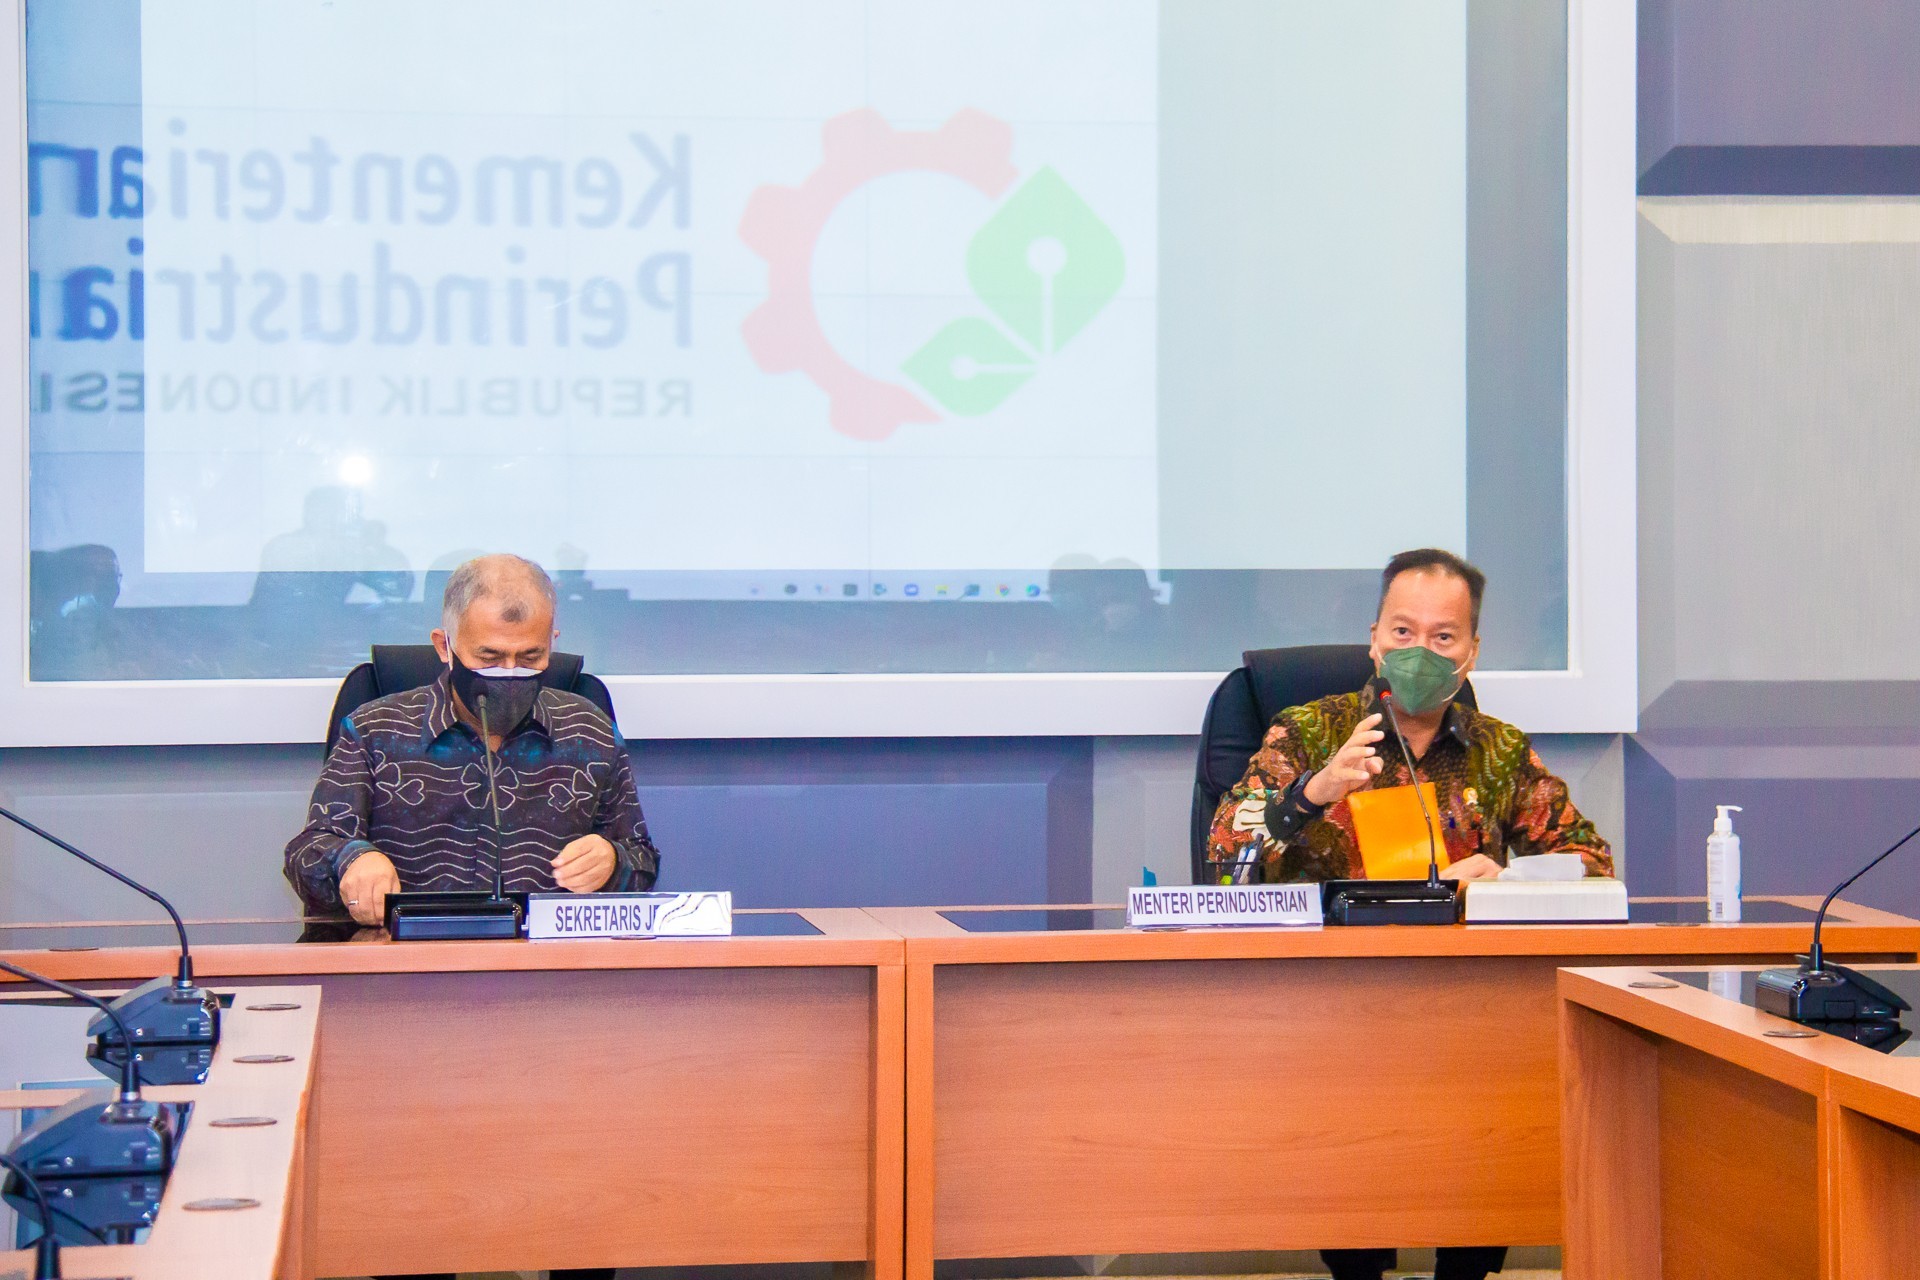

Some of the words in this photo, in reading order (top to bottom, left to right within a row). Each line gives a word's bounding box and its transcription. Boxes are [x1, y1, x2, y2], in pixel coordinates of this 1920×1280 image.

[1132, 891, 1194, 915] MENTERI
[1198, 890, 1308, 914] PERINDUSTRIAN
[555, 904, 641, 932] SEKRETARIS
